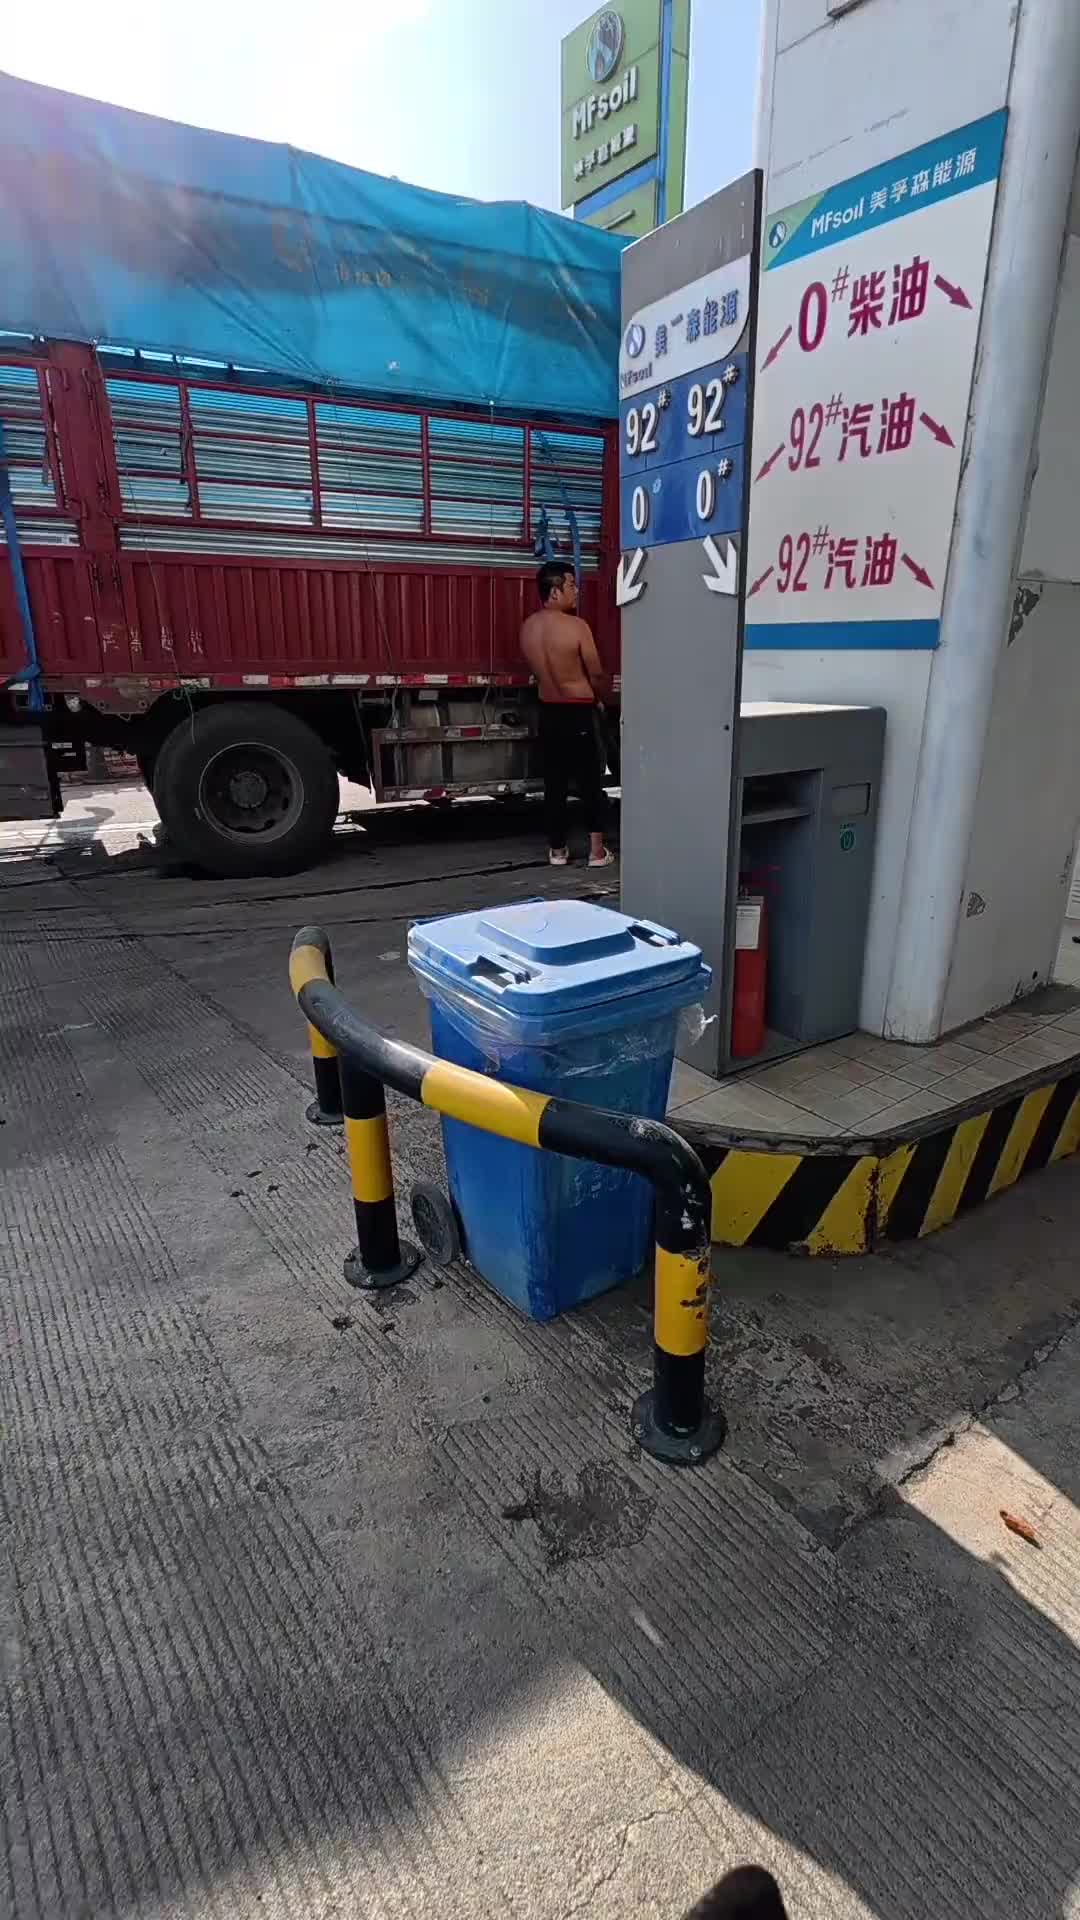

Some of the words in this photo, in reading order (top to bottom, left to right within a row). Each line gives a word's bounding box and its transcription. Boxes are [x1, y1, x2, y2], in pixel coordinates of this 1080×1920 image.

[811, 196, 864, 238] MFsoil
[798, 255, 930, 353] 0#柴油
[626, 388, 672, 456] 92#
[687, 362, 739, 437] 92#
[788, 392, 916, 472] 92#汽油
[776, 524, 898, 594] 92#汽油
